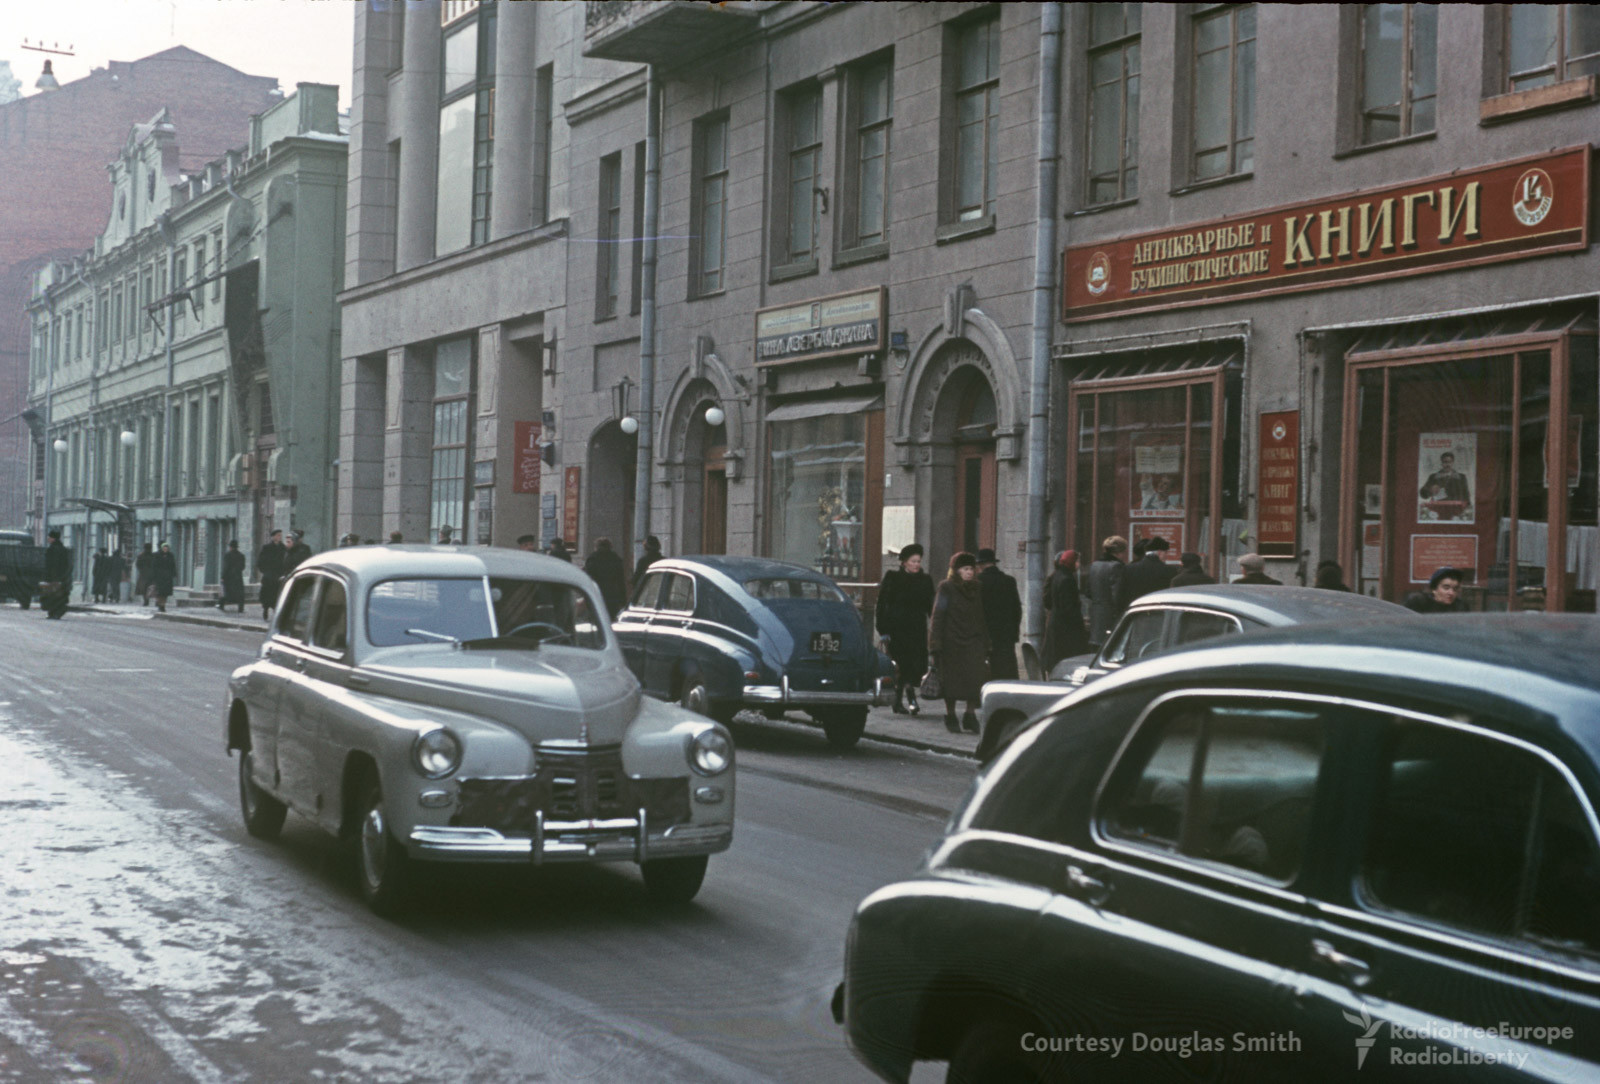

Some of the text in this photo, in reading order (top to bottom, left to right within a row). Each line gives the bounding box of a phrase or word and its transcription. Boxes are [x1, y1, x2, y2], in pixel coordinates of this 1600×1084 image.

[1132, 223, 1255, 265] АНТИКВАРНЫЕ
[1283, 181, 1480, 266] КНИГИ
[1130, 249, 1270, 291] БУКИНИСТИЧЕСКИЕ
